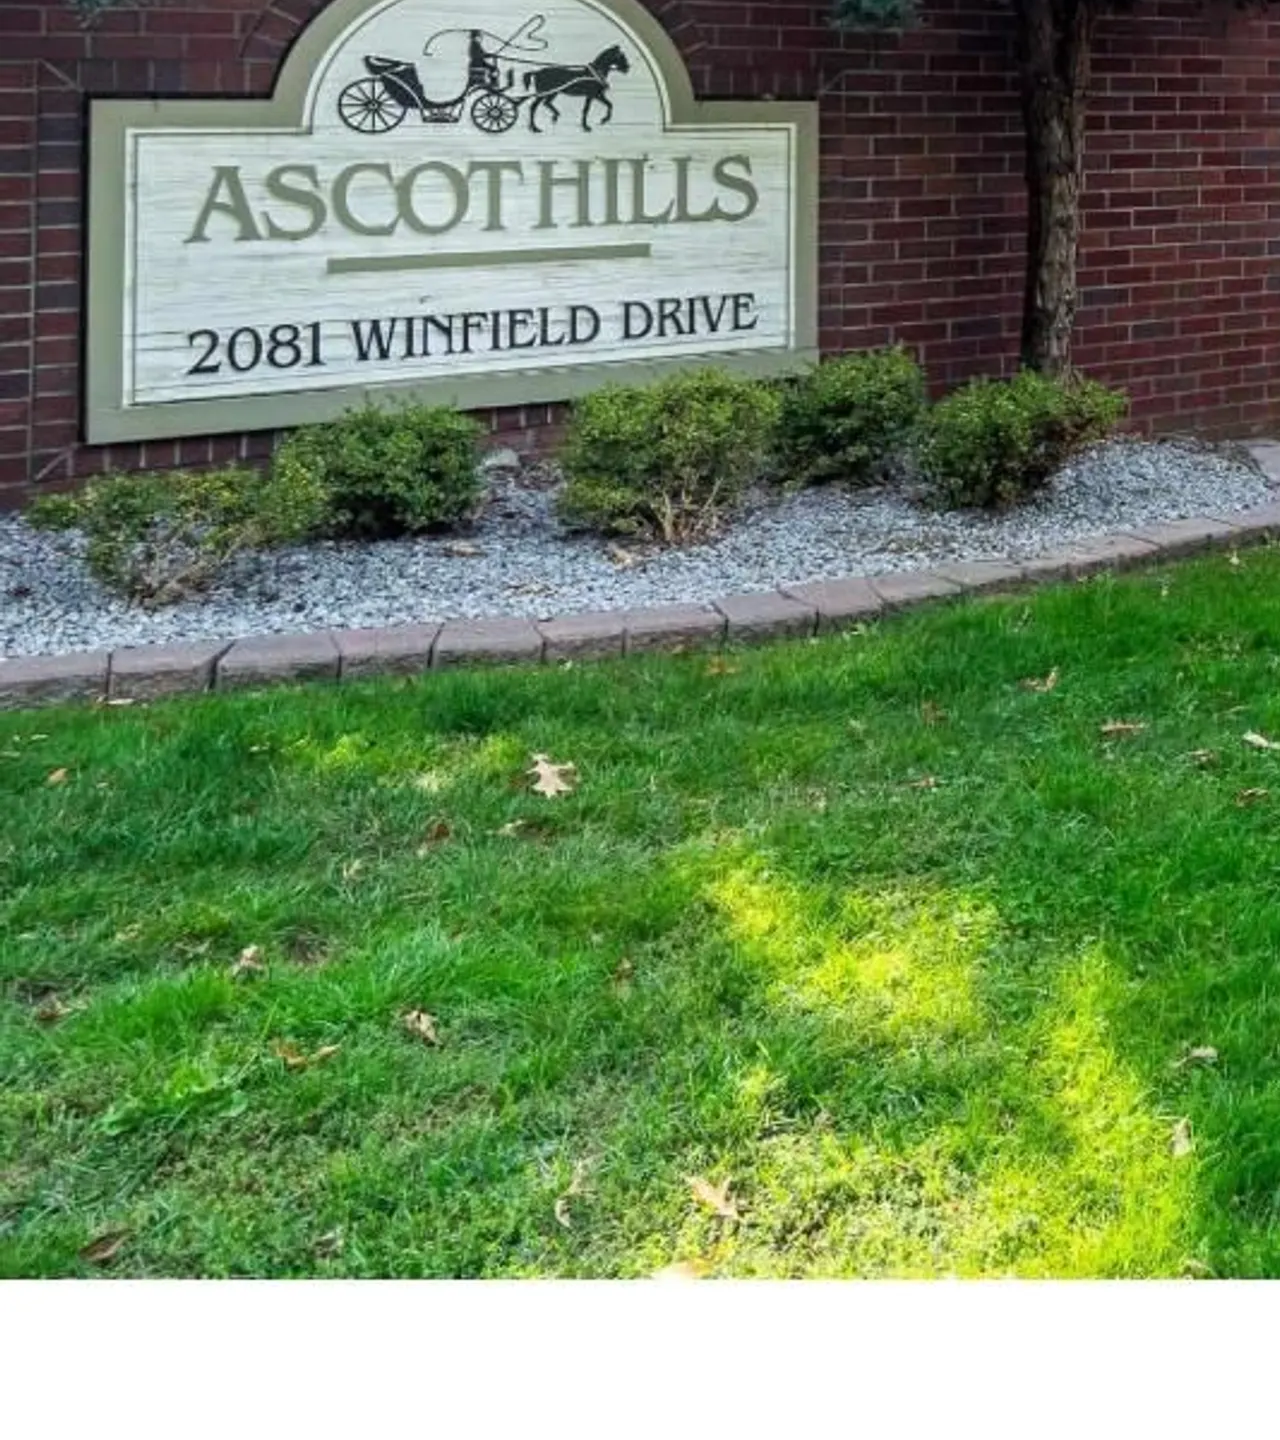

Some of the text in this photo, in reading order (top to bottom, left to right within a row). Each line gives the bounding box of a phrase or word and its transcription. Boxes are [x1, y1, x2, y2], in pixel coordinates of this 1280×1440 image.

[186, 292, 758, 377] 2081 WINFIELD DRIVE
